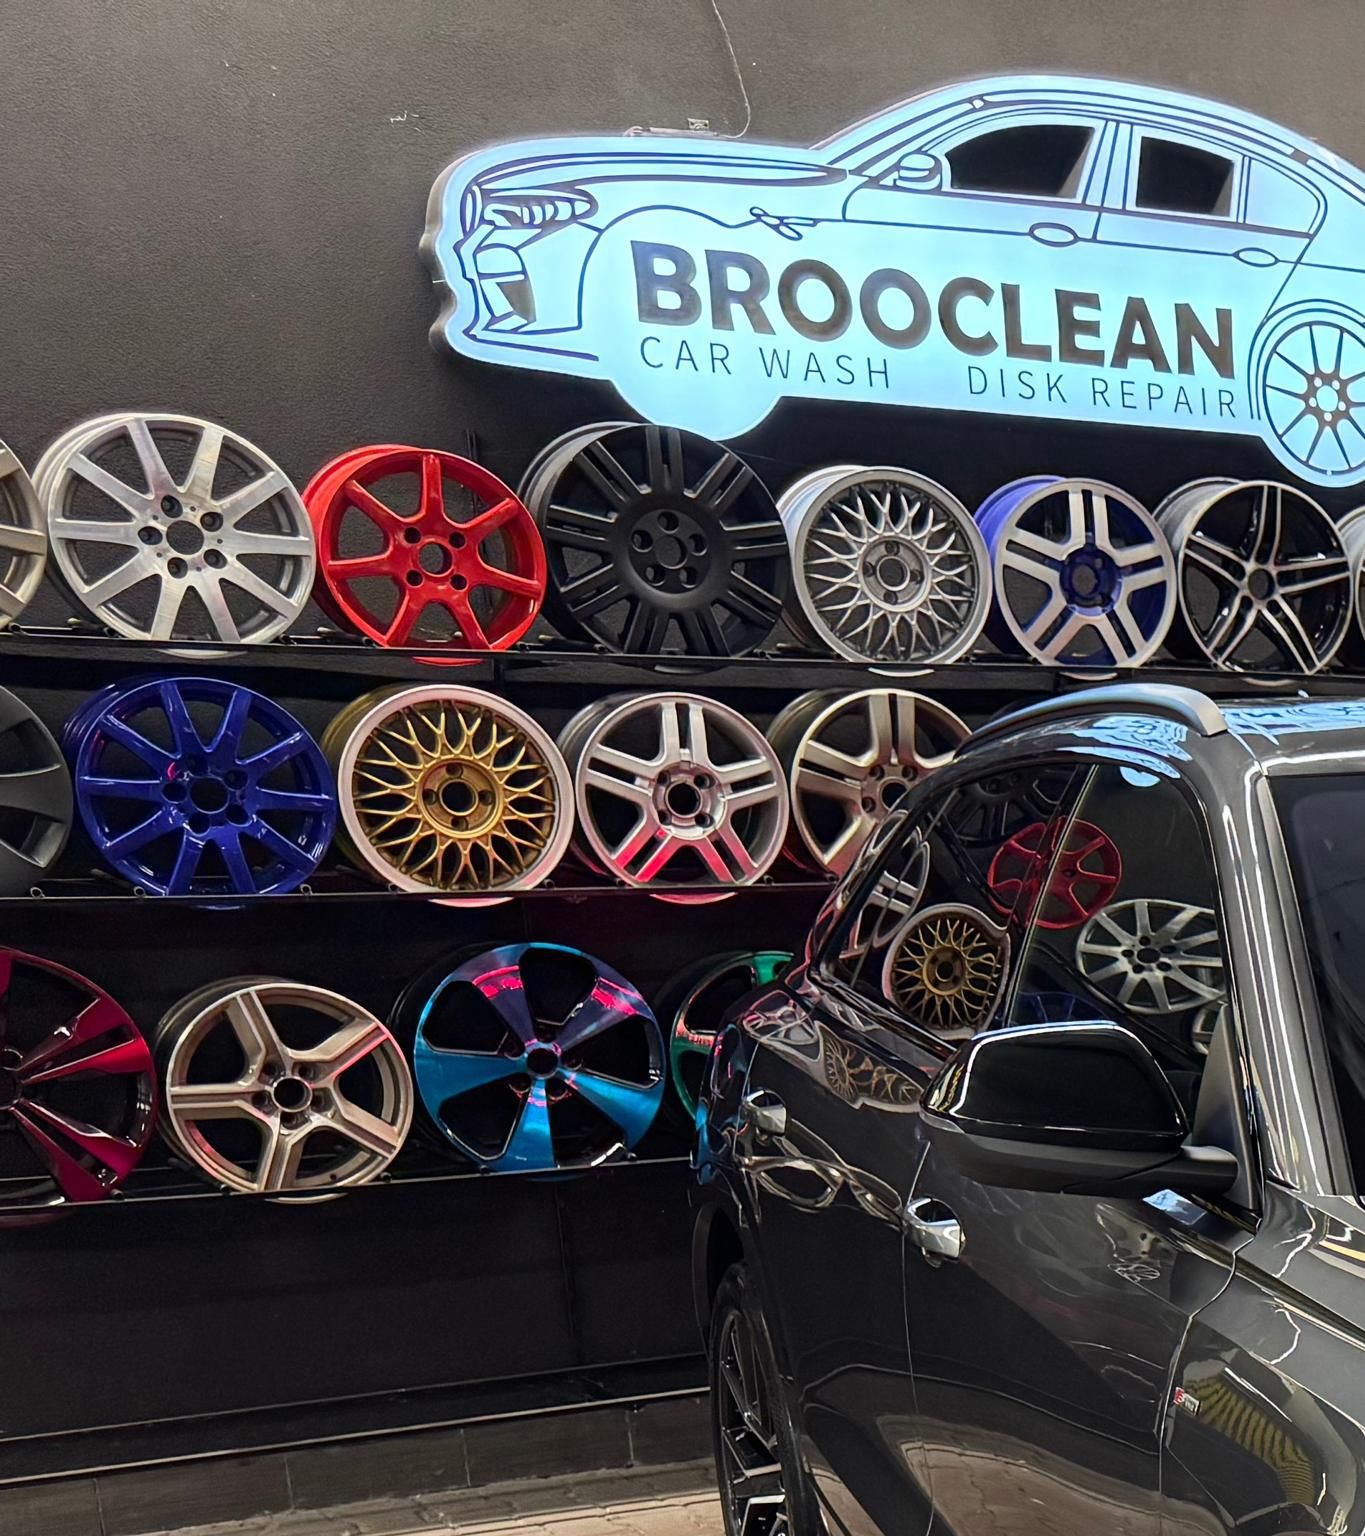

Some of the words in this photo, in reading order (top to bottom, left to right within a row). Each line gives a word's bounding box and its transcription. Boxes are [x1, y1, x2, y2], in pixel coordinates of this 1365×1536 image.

[630, 239, 1236, 381] BROOCLEAN
[639, 335, 732, 375] CAR
[758, 345, 891, 389] WASH
[967, 365, 1067, 404] DISK
[1092, 377, 1236, 419] REPAIR
